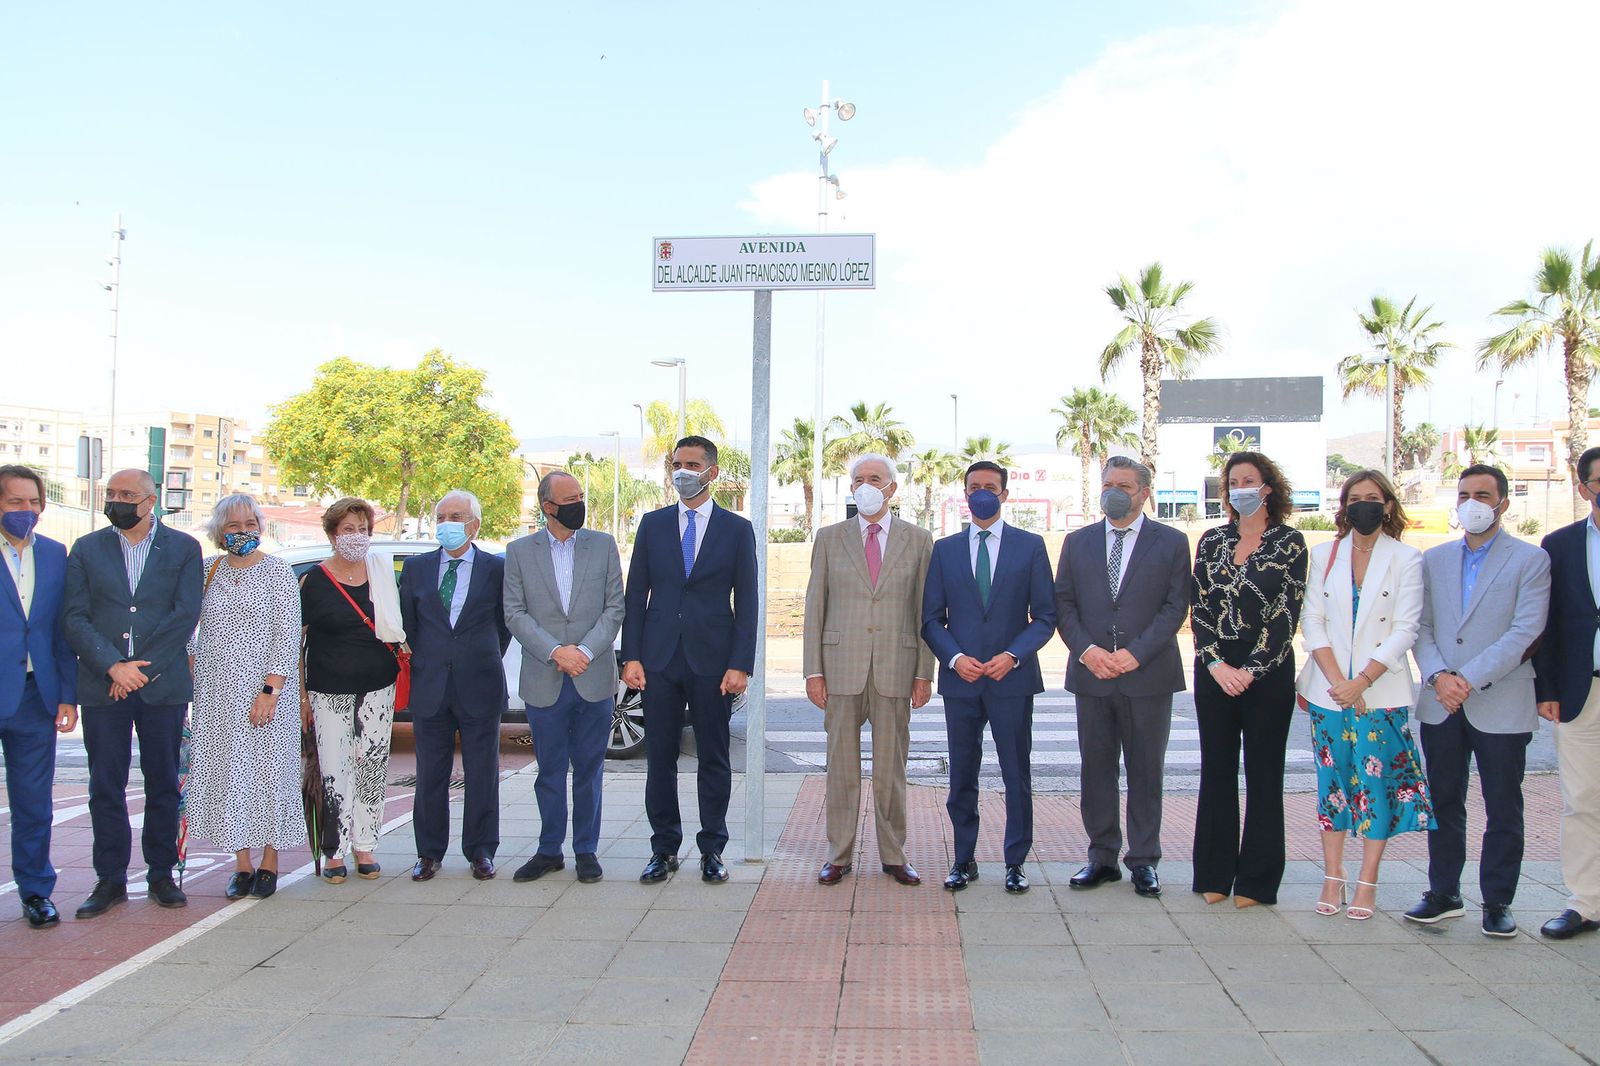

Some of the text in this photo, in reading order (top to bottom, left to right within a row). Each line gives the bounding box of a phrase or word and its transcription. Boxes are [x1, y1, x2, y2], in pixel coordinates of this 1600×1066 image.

[739, 241, 806, 253] AVENIDA
[657, 258, 869, 283] DEL ALCALDE JUAN FRANCISCO MEGINO LÓPEZ
